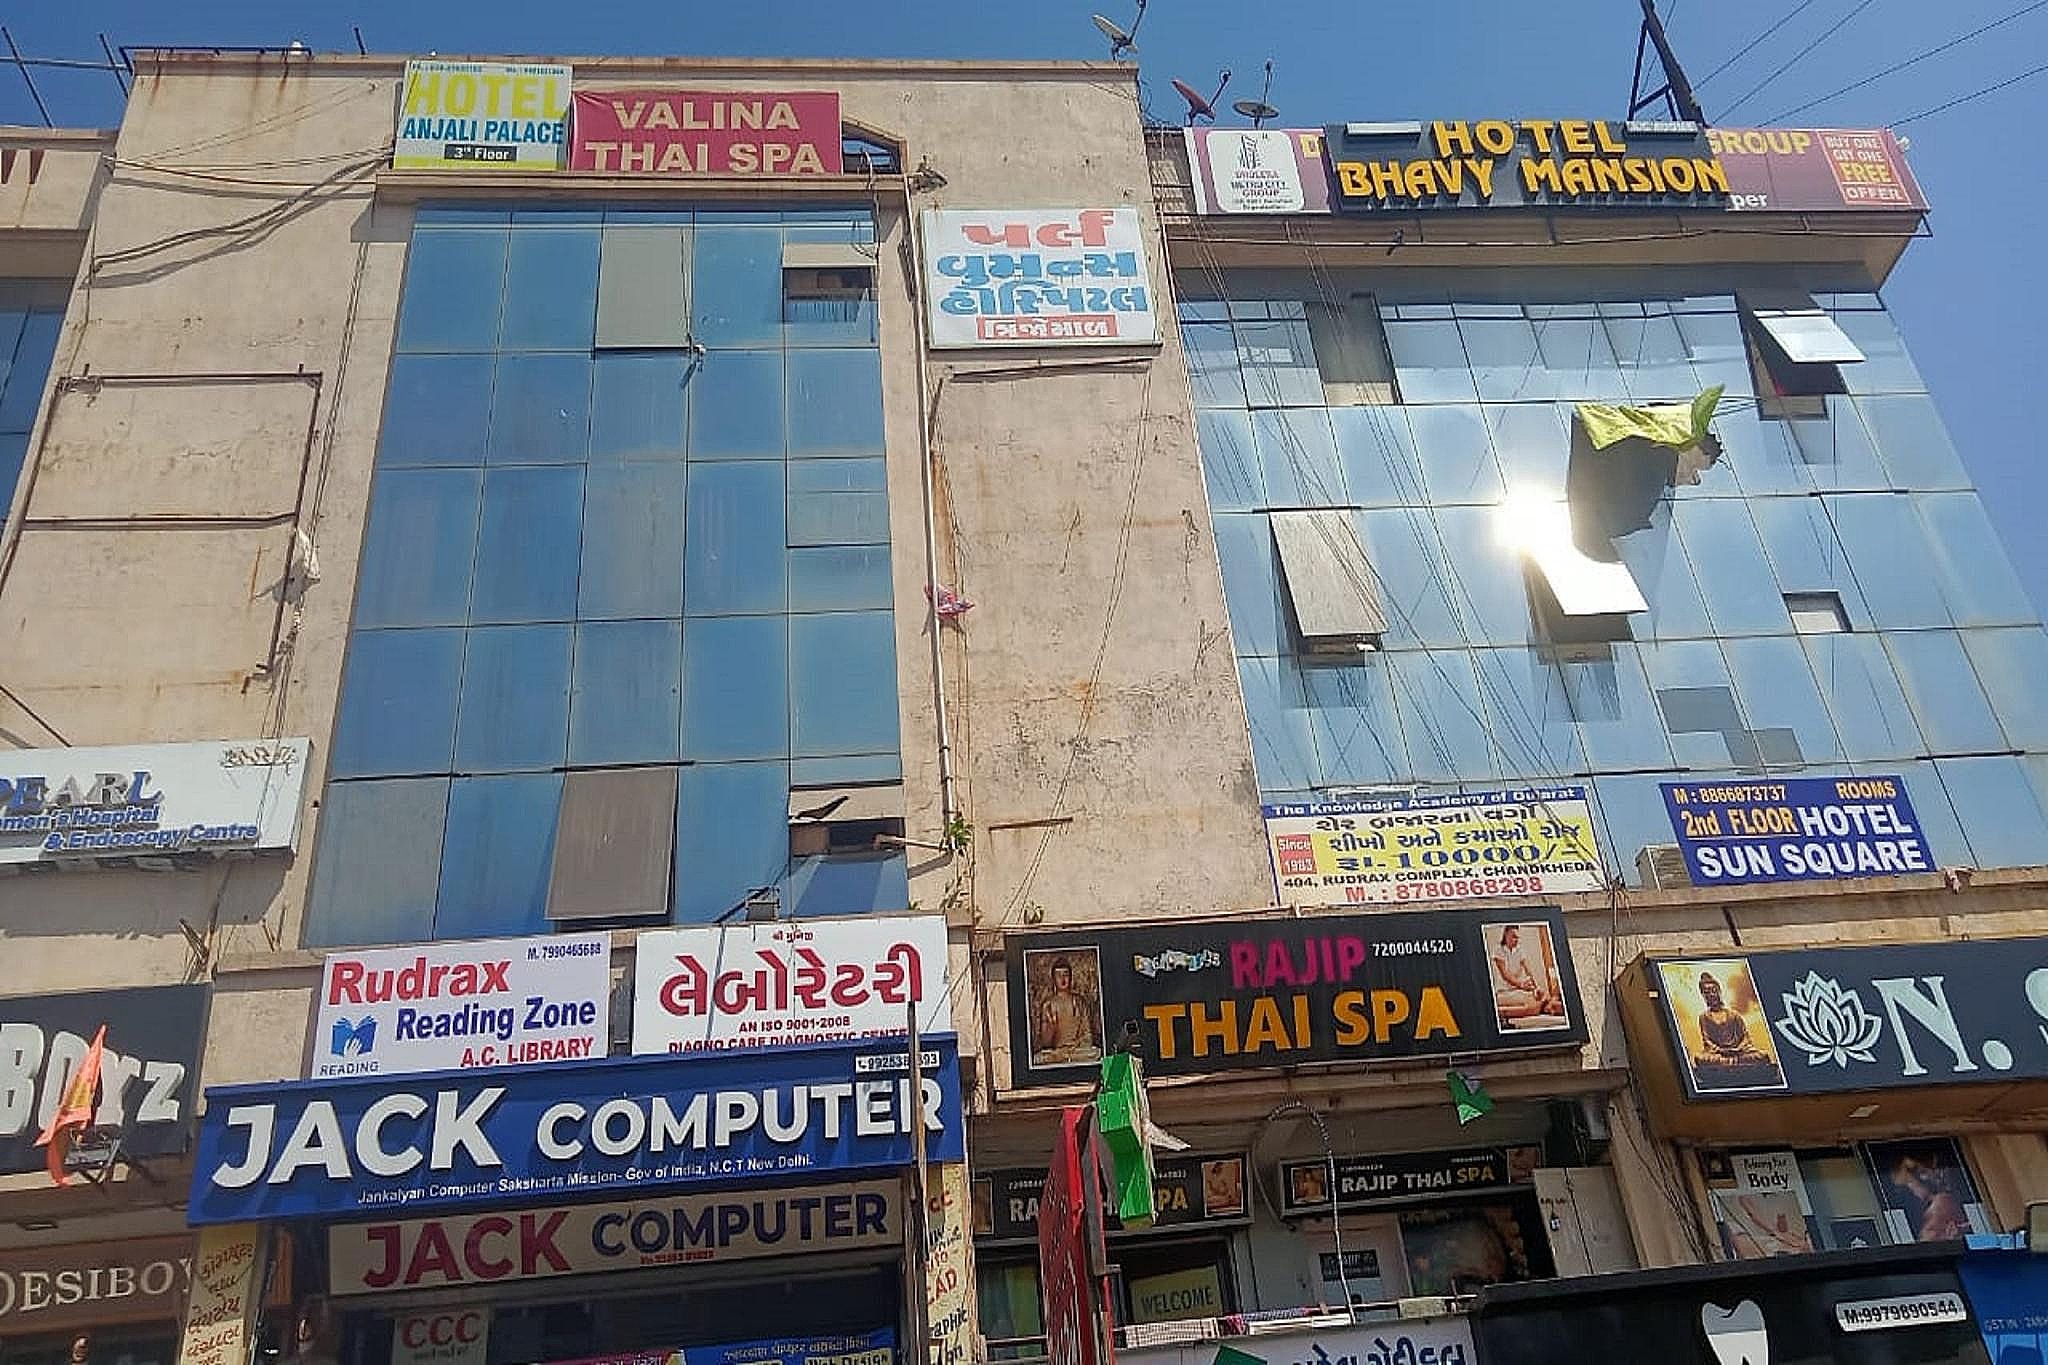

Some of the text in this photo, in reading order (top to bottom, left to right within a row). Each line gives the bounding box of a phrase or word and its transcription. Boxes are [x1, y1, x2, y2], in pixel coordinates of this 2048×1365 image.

[406, 73, 567, 119] HOTEL
[613, 101, 799, 131] VALINA
[403, 117, 564, 144] ANJALI PALACE
[1433, 120, 1626, 157] HOTEL
[1825, 137, 1881, 148] BUY ONE
[475, 147, 510, 160] Floor
[584, 141, 826, 174] THAI SPA
[1833, 150, 1885, 161] GET ONE
[1337, 157, 1731, 199] BHAVY MANSION
[1840, 163, 1891, 182] FREE
[1846, 186, 1904, 200] OFFER
[1274, 804, 1305, 816] The
[1310, 799, 1403, 815] Knowledge
[1408, 796, 1486, 810] Academy
[1490, 793, 1506, 803] of
[1835, 781, 1897, 800] ROOMS
[0, 804, 159, 829] men's Hospital
[1681, 804, 1914, 837] 2nd FLOOR HOTEL
[45, 824, 257, 850] & Endoscopy Centre
[1279, 837, 1311, 851] Since
[1697, 840, 1927, 878] SUN SQUARE
[1324, 872, 1389, 887] RUDRAX
[1483, 863, 1595, 877] CHANDKHEDA
[1396, 876, 1544, 899] 8780868298
[1229, 935, 1366, 989] RAJIP
[328, 957, 512, 1005] Rudrax
[659, 942, 923, 1016] લેબોરેટરી
[396, 996, 596, 1040] Reading Zone
[739, 1022, 757, 1034] AN
[761, 1020, 783, 1032] ISO
[1143, 985, 1461, 1059] THAI SPA
[460, 1037, 594, 1067] A.C. LIBRARY
[668, 1039, 724, 1054] DIAGNO
[728, 1037, 766, 1049] CARE
[861, 1028, 909, 1038] CENTE
[320, 1061, 379, 1076] READING
[212, 1078, 944, 1188] JACK COMPUTER
[358, 1187, 426, 1206] Jankalyan
[429, 1181, 495, 1199] Computer
[655, 1166, 668, 1179] of
[747, 1156, 775, 1171] New
[1341, 1165, 1495, 1193] RAJIP THAI SPA
[1748, 1172, 1788, 1189] Body
[1155, 1186, 1188, 1212] PA
[362, 1193, 889, 1288] JACK COMPUTER
[0, 1259, 193, 1317] ESIBO
[1142, 1287, 1214, 1316] WELCOME
[402, 1312, 480, 1349] CCC
